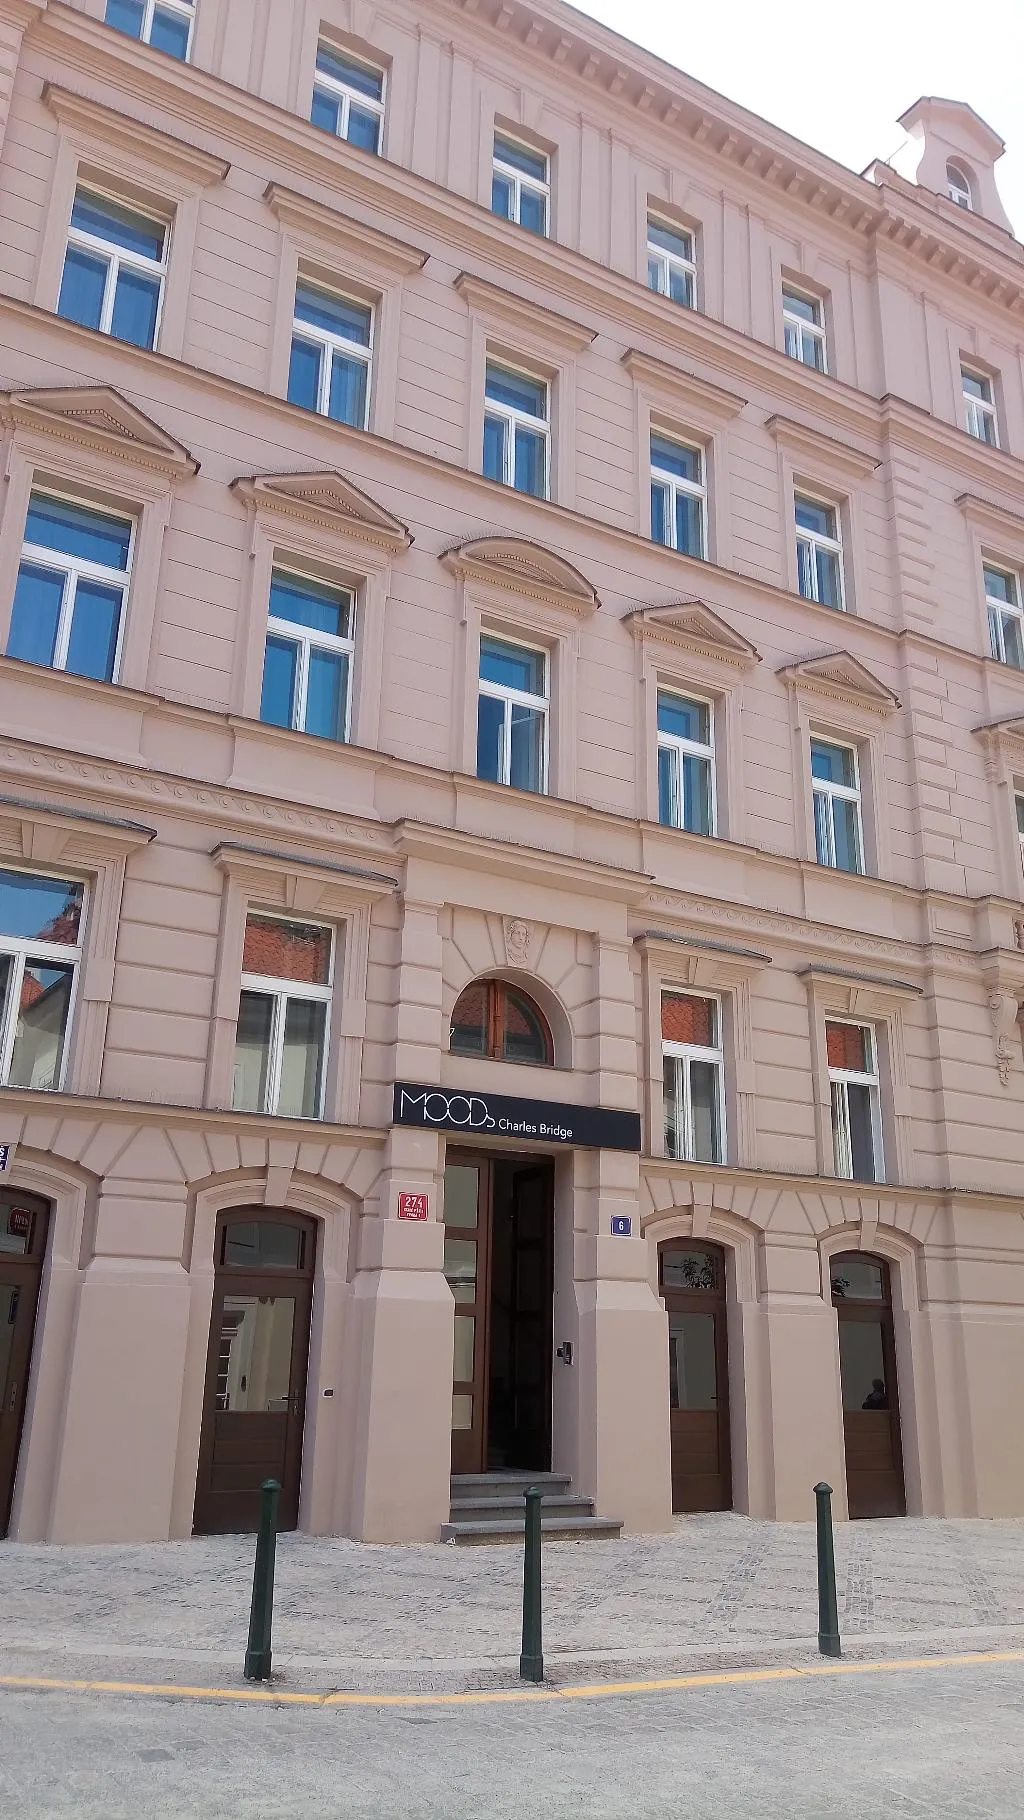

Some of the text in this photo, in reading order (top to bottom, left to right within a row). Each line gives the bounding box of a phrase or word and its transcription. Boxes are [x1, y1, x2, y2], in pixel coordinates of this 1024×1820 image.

[498, 1118, 537, 1133] Charles
[539, 1123, 573, 1140] Bridge
[405, 1196, 422, 1208] 274
[618, 1220, 624, 1231] 6
